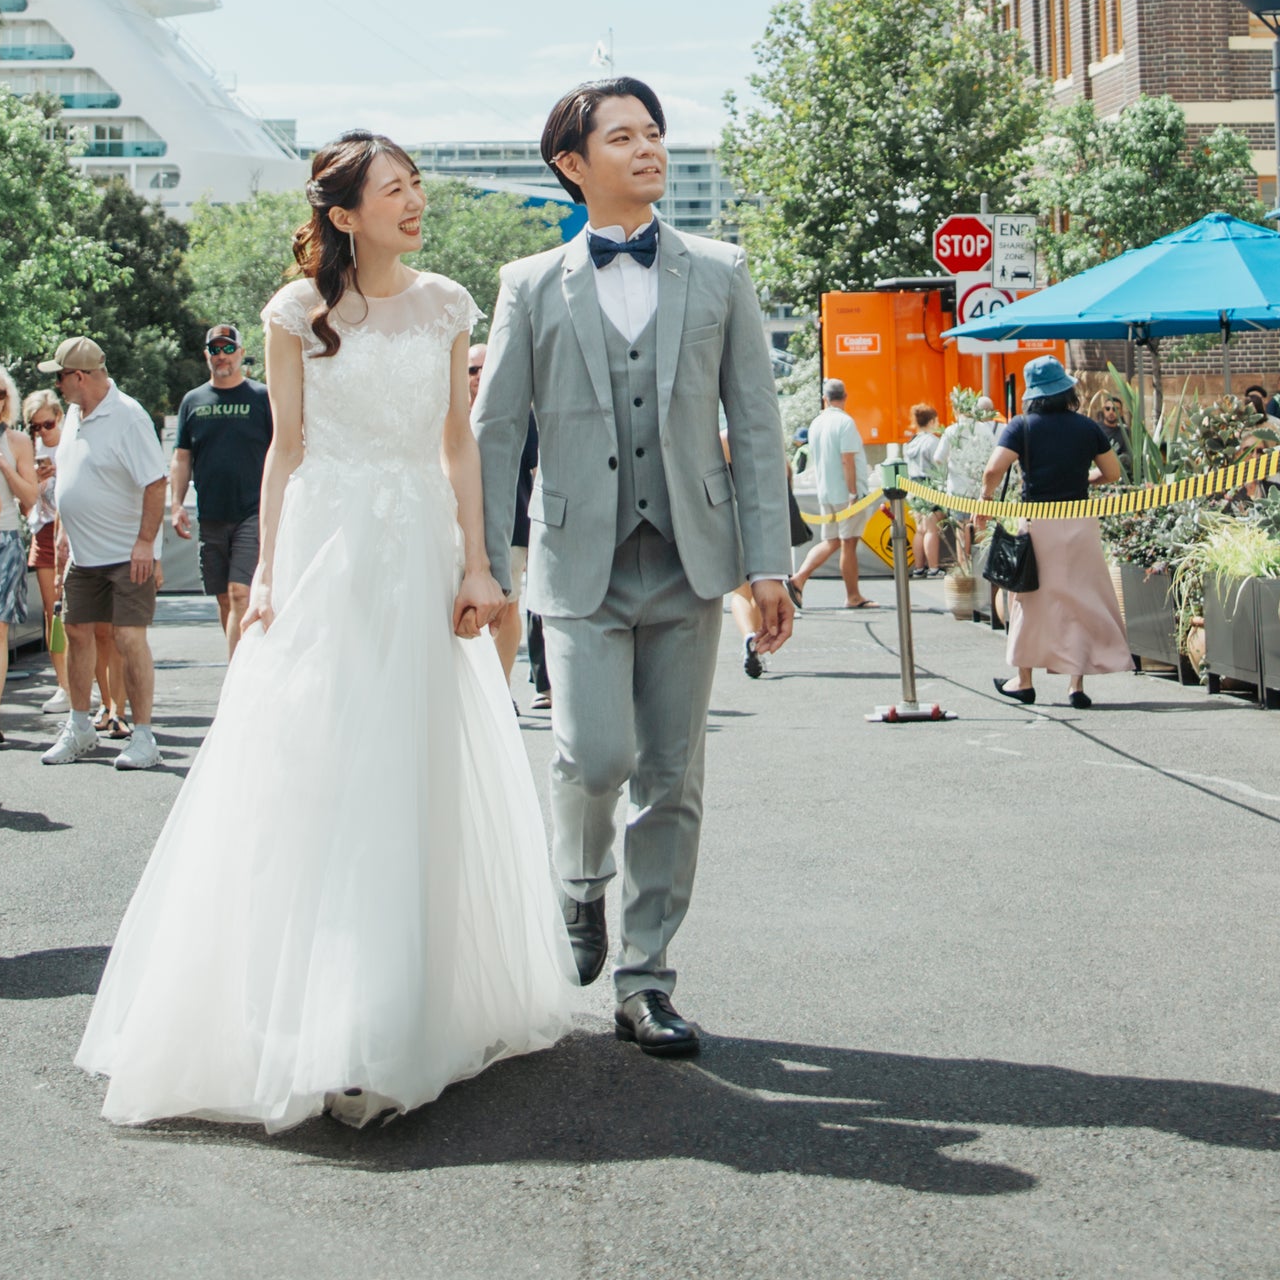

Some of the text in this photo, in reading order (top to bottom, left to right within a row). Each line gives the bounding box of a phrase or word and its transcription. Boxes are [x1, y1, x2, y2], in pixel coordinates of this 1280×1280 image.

[938, 234, 989, 258] STOP
[1004, 253, 1025, 261] ZONE
[212, 404, 250, 415] KUIU
